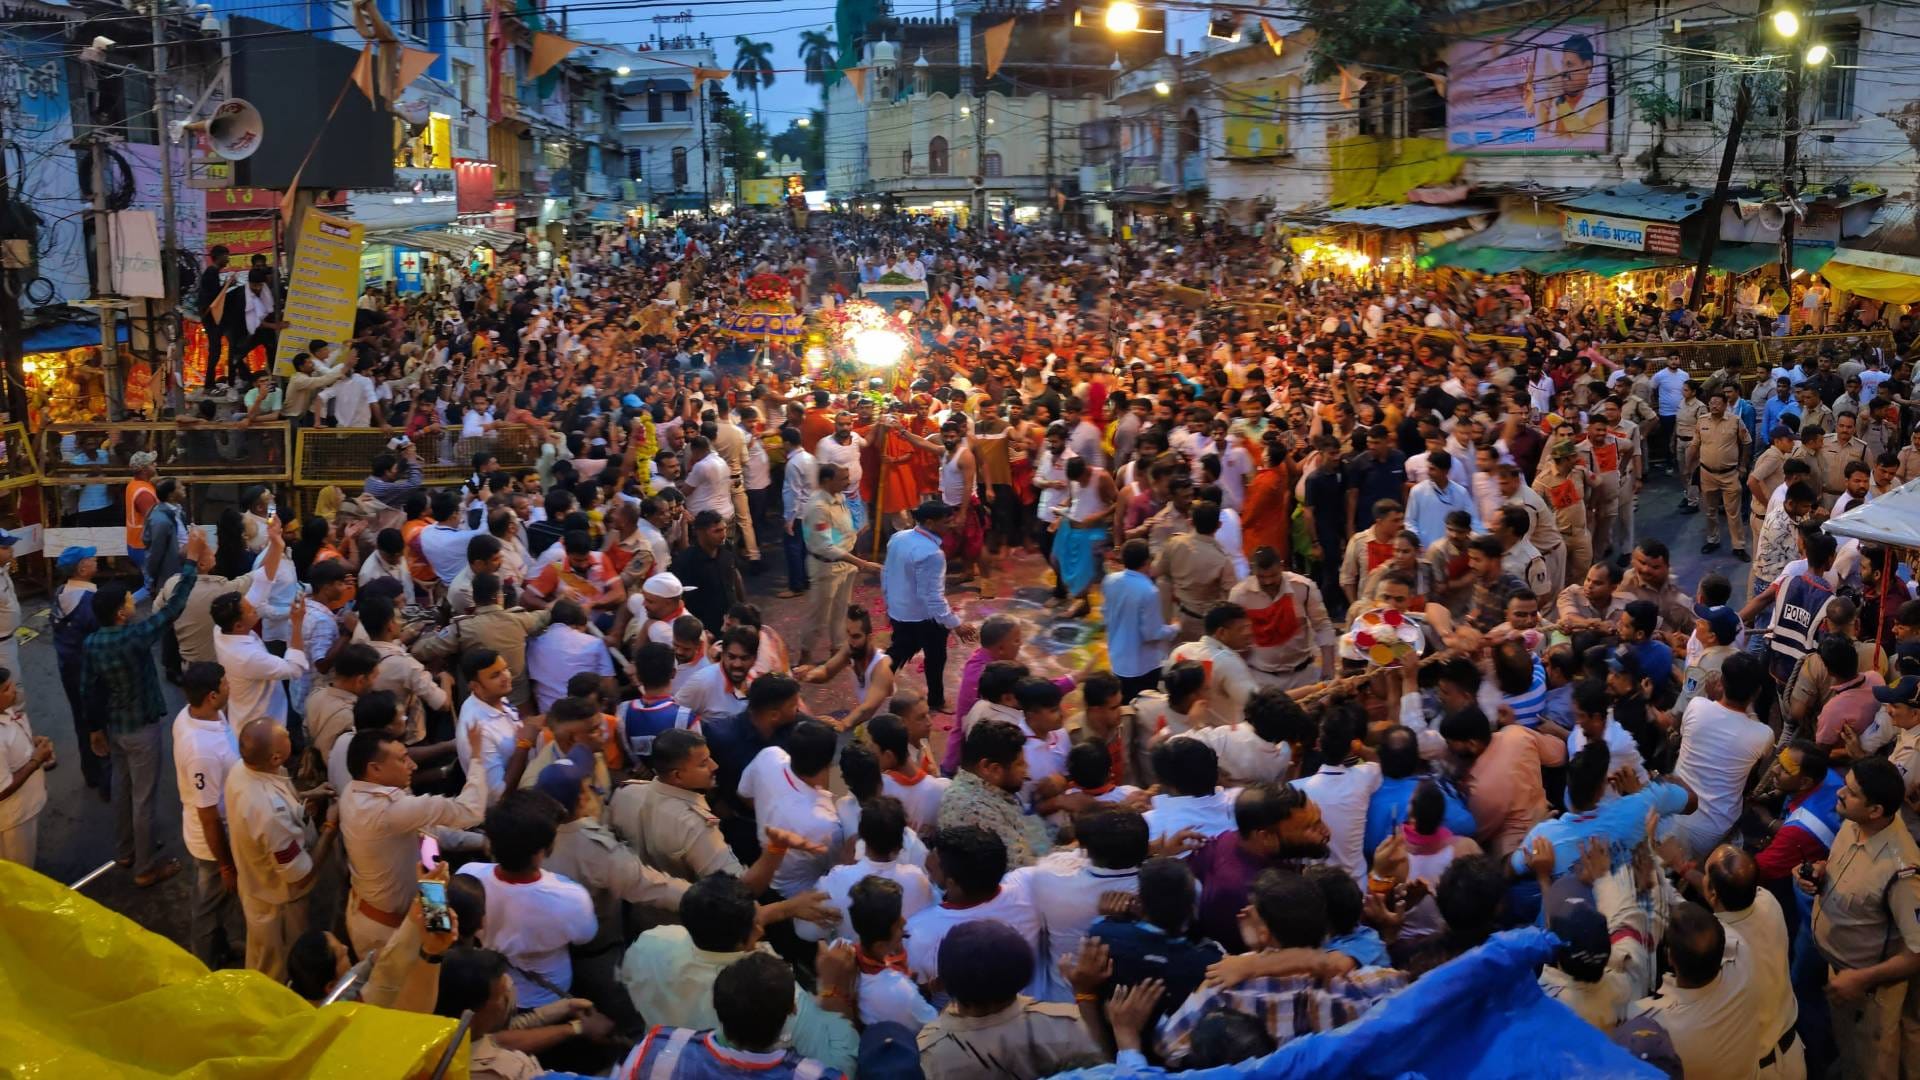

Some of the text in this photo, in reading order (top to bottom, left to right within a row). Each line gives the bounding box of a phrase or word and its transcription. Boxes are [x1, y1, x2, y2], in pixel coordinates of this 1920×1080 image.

[1578, 218, 1590, 237] श्री
[1612, 228, 1642, 245] भण्डार
[194, 772, 205, 791] 3
